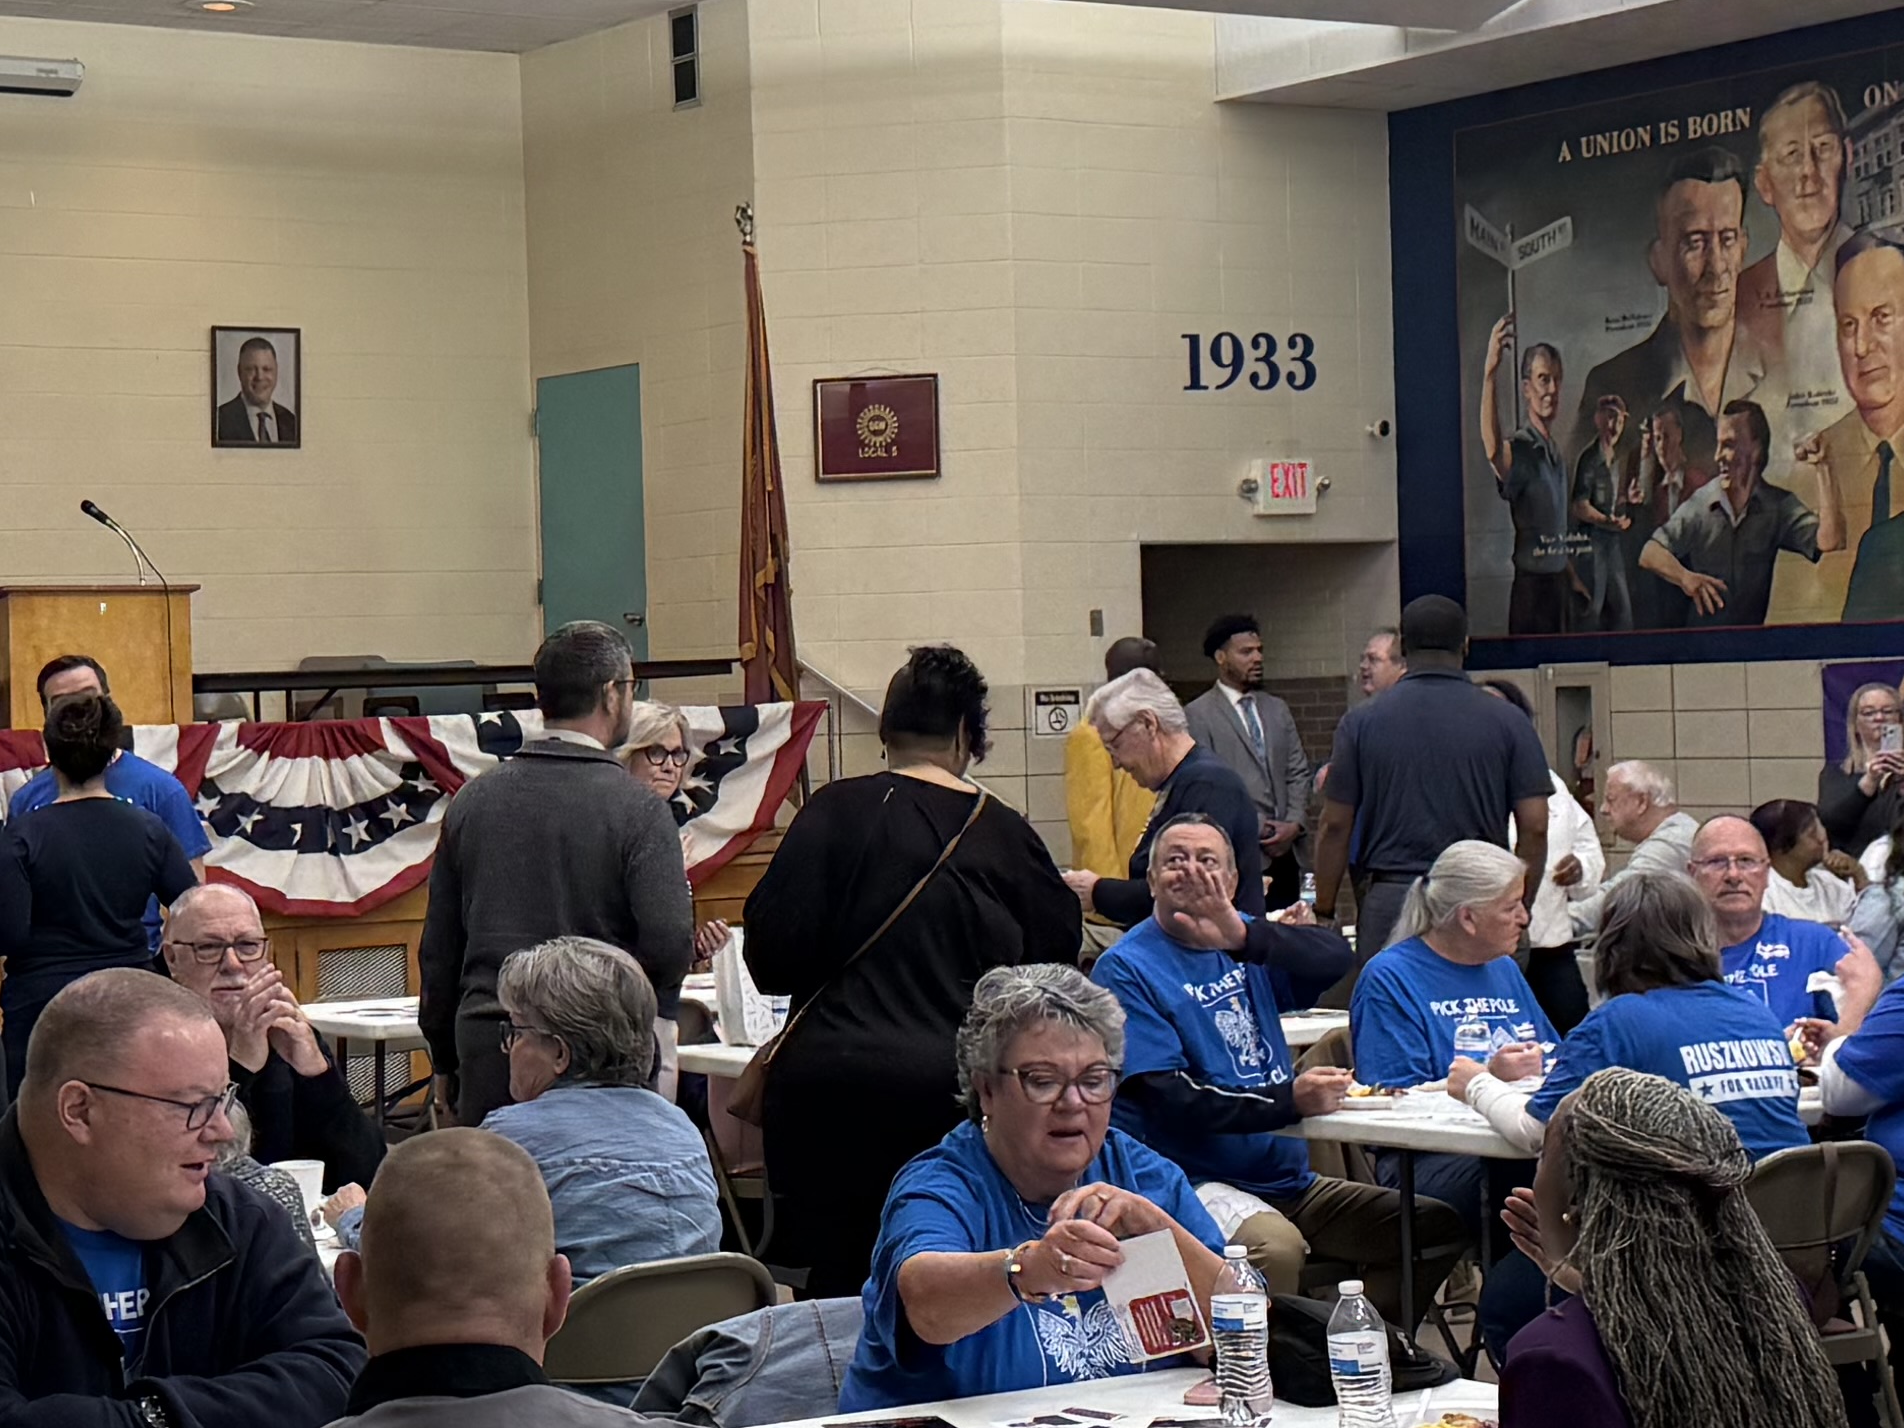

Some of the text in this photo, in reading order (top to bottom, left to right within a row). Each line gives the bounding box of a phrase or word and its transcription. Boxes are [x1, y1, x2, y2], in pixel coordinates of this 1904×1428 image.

[1864, 81, 1899, 109] ON
[1558, 107, 1752, 163] A UNION IS BORN
[1518, 231, 1556, 261] SOUTH
[1181, 331, 1317, 391] 1933
[1270, 462, 1309, 499] EXIT
[1430, 998, 1462, 1016] PICK
[1720, 1079, 1745, 1094] FOR
